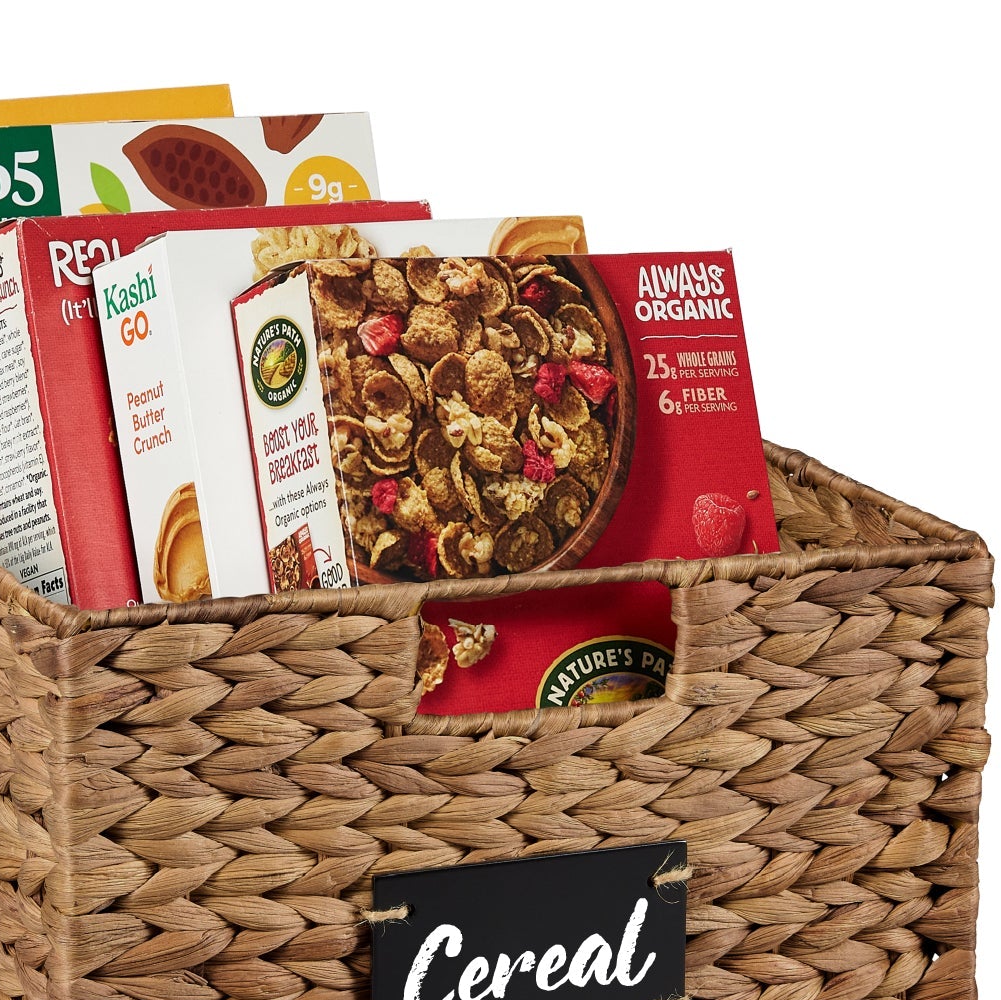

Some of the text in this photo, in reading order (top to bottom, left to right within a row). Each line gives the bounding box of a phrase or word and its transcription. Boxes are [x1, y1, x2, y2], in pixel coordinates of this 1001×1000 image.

[308, 174, 344, 204] 9g
[103, 263, 157, 320] Kashi
[638, 262, 725, 299] ALWAYS
[635, 298, 733, 321] ORGANIC
[253, 323, 302, 367] NATURE'S PATH
[643, 351, 737, 380] 25g WHOLE GRAINS
[679, 368, 739, 378] PER SERVING
[126, 380, 164, 410] Peanut
[268, 379, 297, 402] ORGANIC
[658, 387, 727, 415] 6g FIBER
[132, 406, 165, 432] Butter
[685, 402, 737, 413] PER SERVING
[134, 425, 172, 455] Crunch
[12, 491, 25, 506] wheat
[25, 487, 34, 500] and
[287, 490, 304, 503] these
[306, 479, 329, 494] Always
[21, 501, 37, 517] facility
[37, 498, 48, 510] that
[275, 498, 327, 528] Organic options
[5, 528, 14, 538] tree
[22, 518, 32, 530] and
[20, 564, 39, 579] VEGAN
[321, 562, 343, 588] GOOD
[41, 576, 64, 595] Facts
[547, 648, 674, 706] NATURE'S PA
